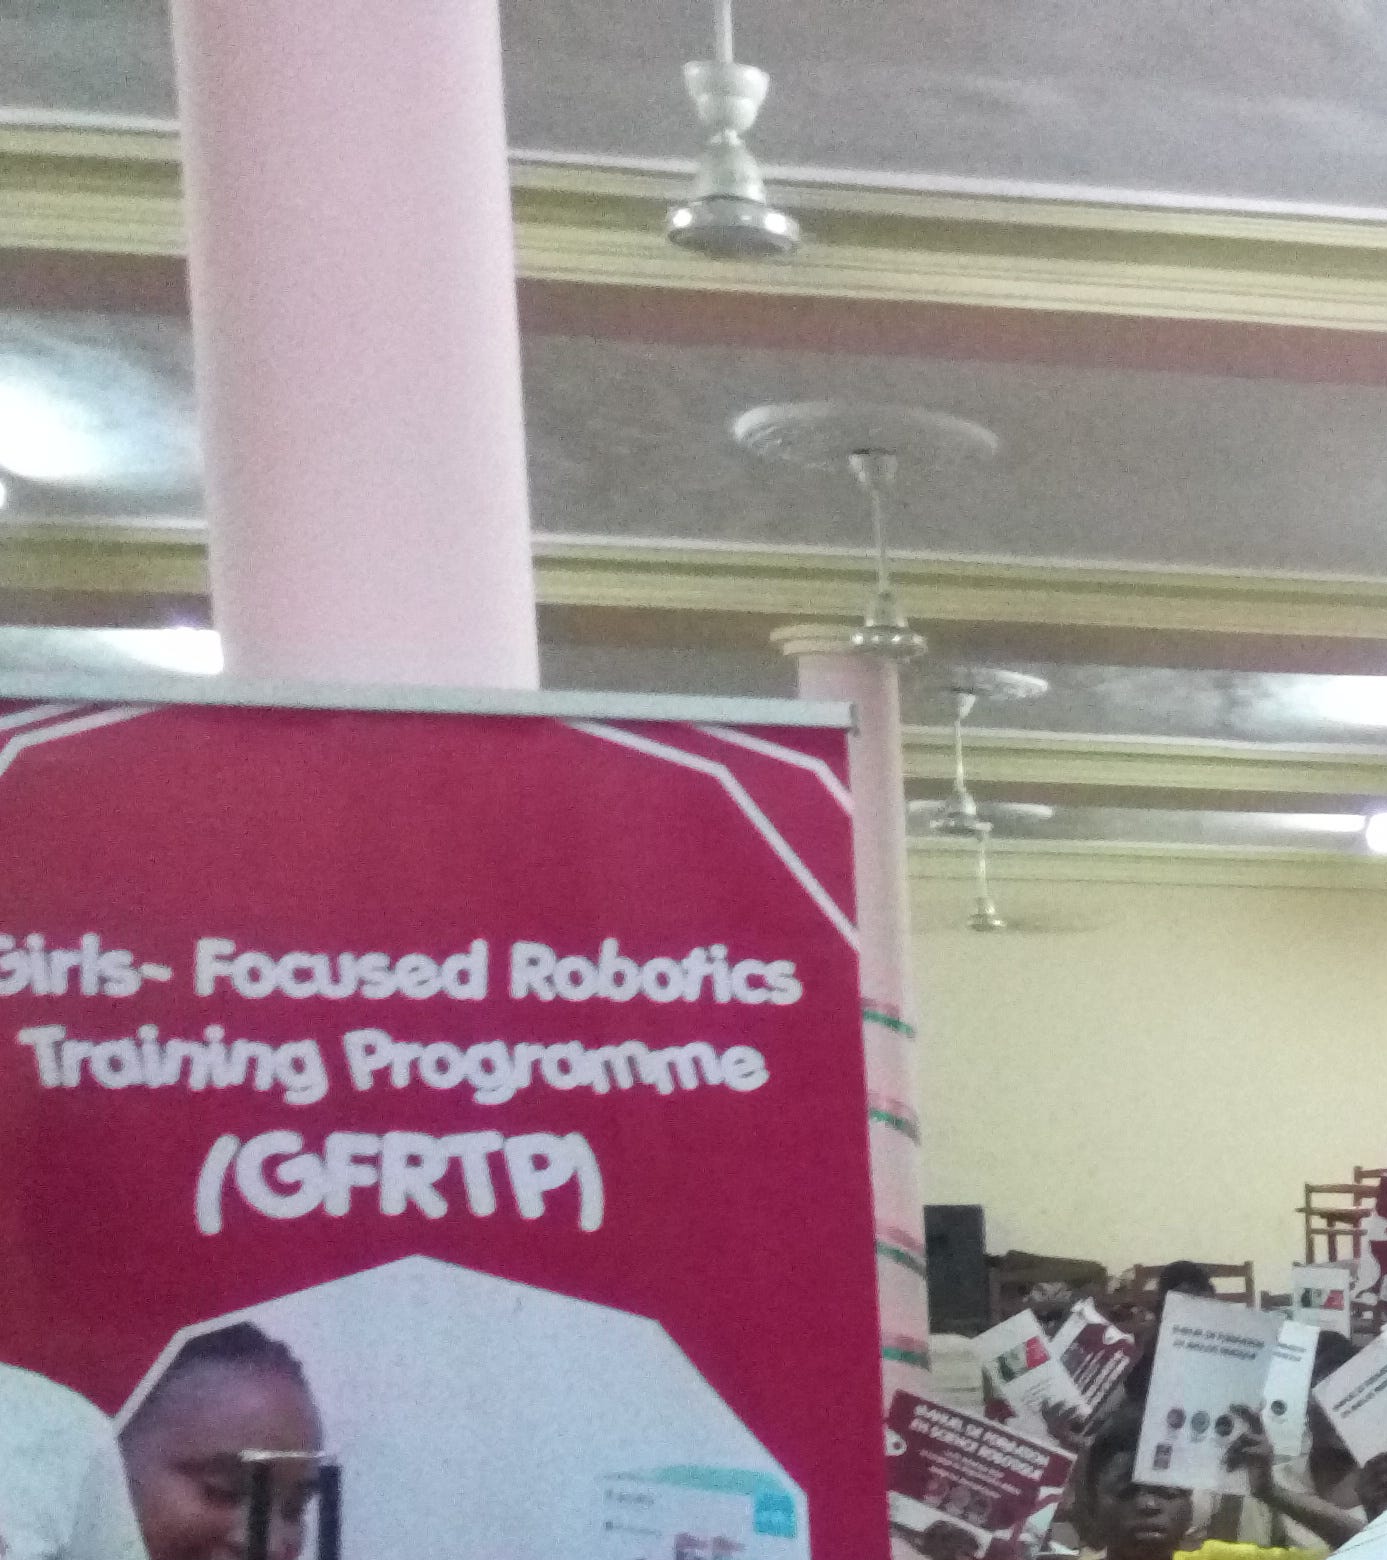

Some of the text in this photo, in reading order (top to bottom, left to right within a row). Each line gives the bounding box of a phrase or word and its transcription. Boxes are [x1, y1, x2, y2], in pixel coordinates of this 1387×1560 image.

[194, 936, 489, 1000] Focused
[509, 937, 804, 1005] Robotics
[17, 1023, 770, 1106] Training Programme
[195, 1130, 605, 1236] (GFRTP)
